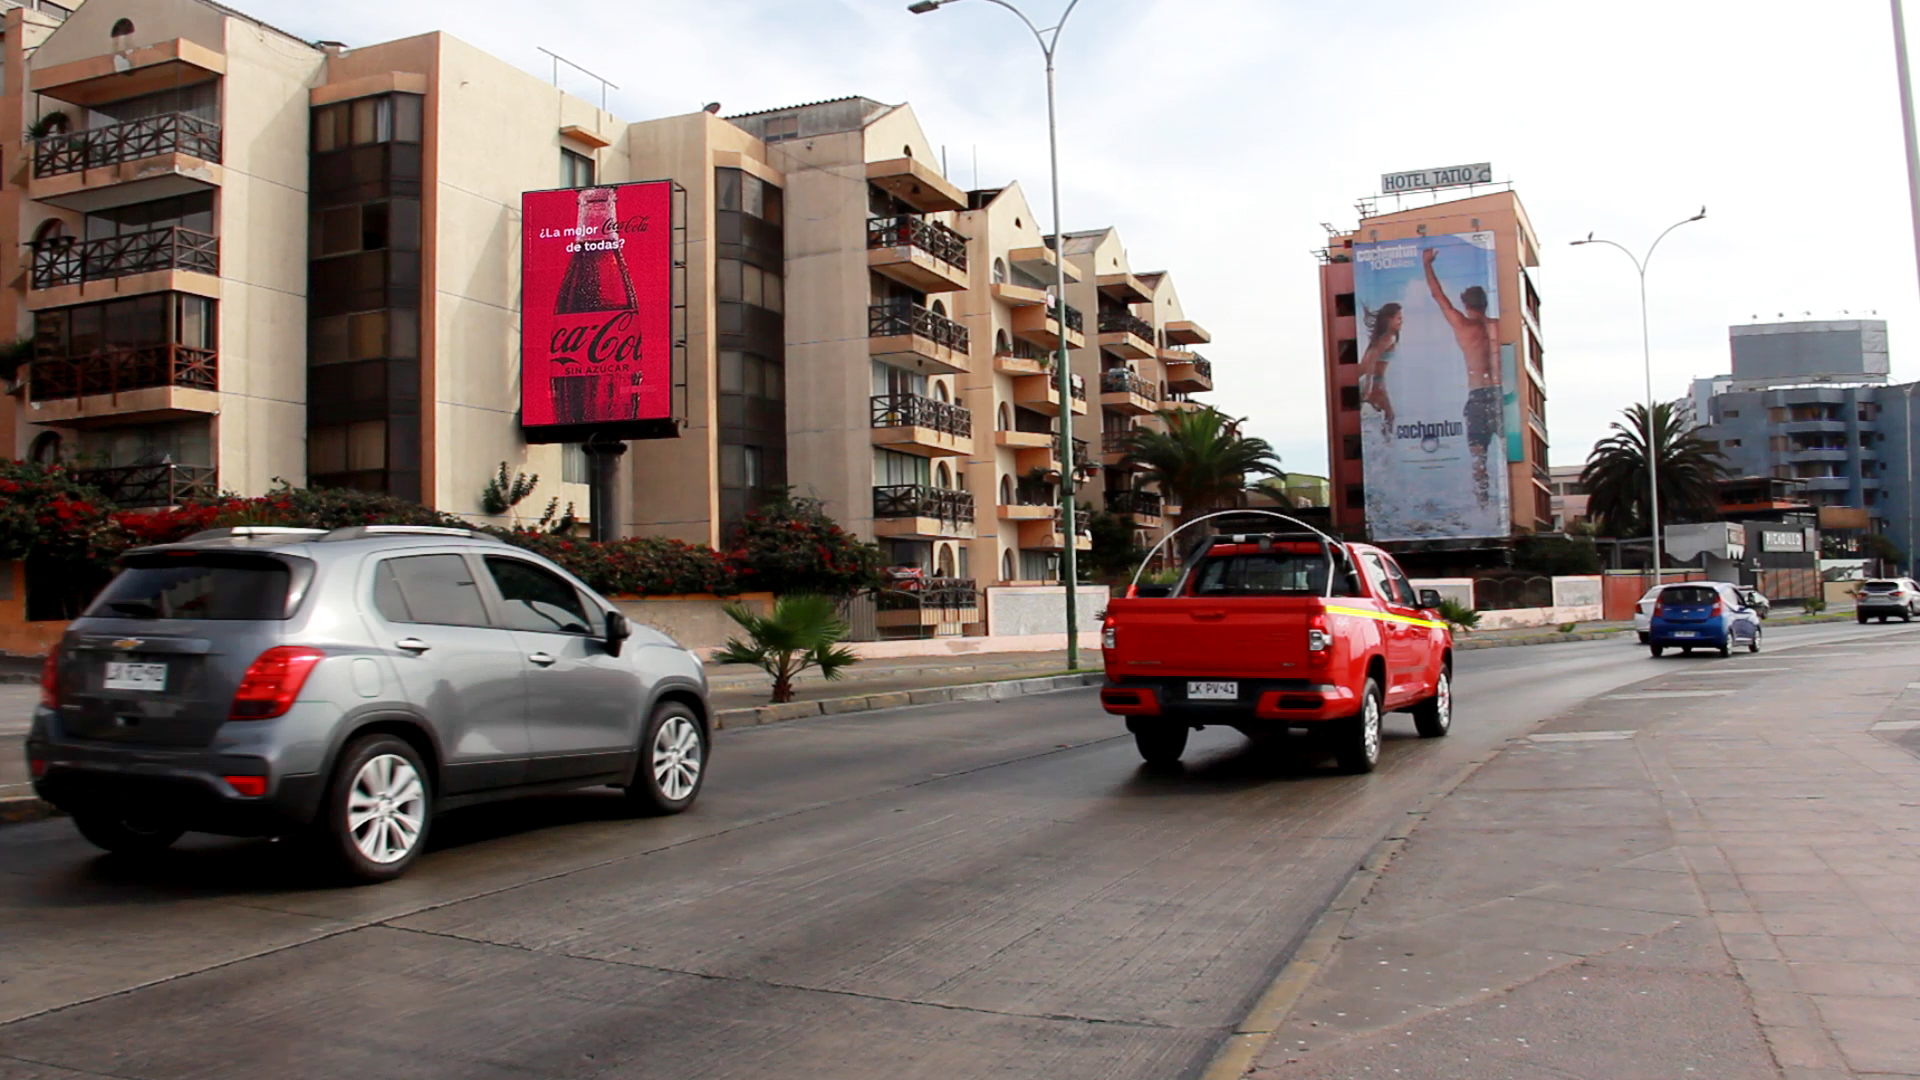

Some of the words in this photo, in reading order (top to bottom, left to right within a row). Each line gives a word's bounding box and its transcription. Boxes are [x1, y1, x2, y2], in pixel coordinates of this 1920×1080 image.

[1385, 173, 1429, 190] HOTEL
[1432, 168, 1472, 184] TATIO
[540, 228, 560, 238] ¿La
[564, 225, 598, 237] mejor
[566, 242, 581, 252] de
[584, 239, 625, 251] todas?
[1370, 258, 1391, 270] 100
[565, 367, 582, 375] SIN
